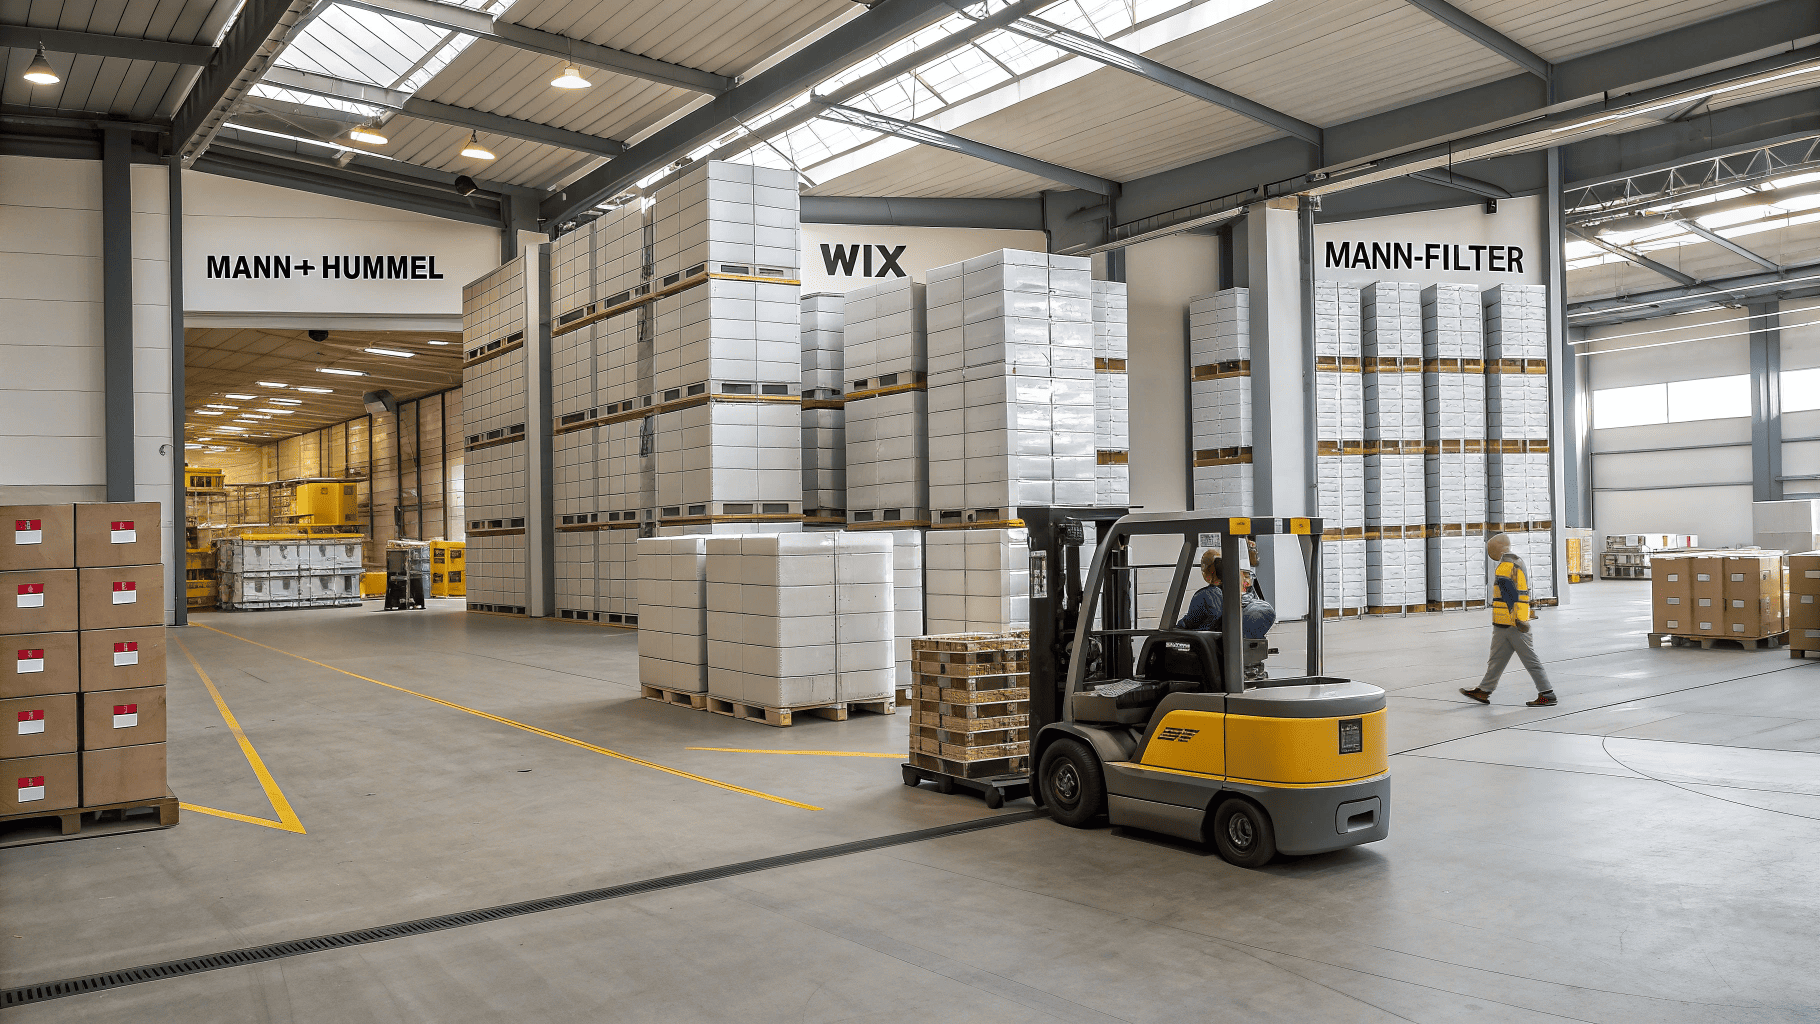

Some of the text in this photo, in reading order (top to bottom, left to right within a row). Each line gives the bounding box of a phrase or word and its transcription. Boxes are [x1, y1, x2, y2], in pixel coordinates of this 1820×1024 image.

[207, 255, 444, 280] MANN+ HUMMEL
[819, 243, 908, 278] WIX
[1325, 241, 1524, 273] MANN-FILTER
